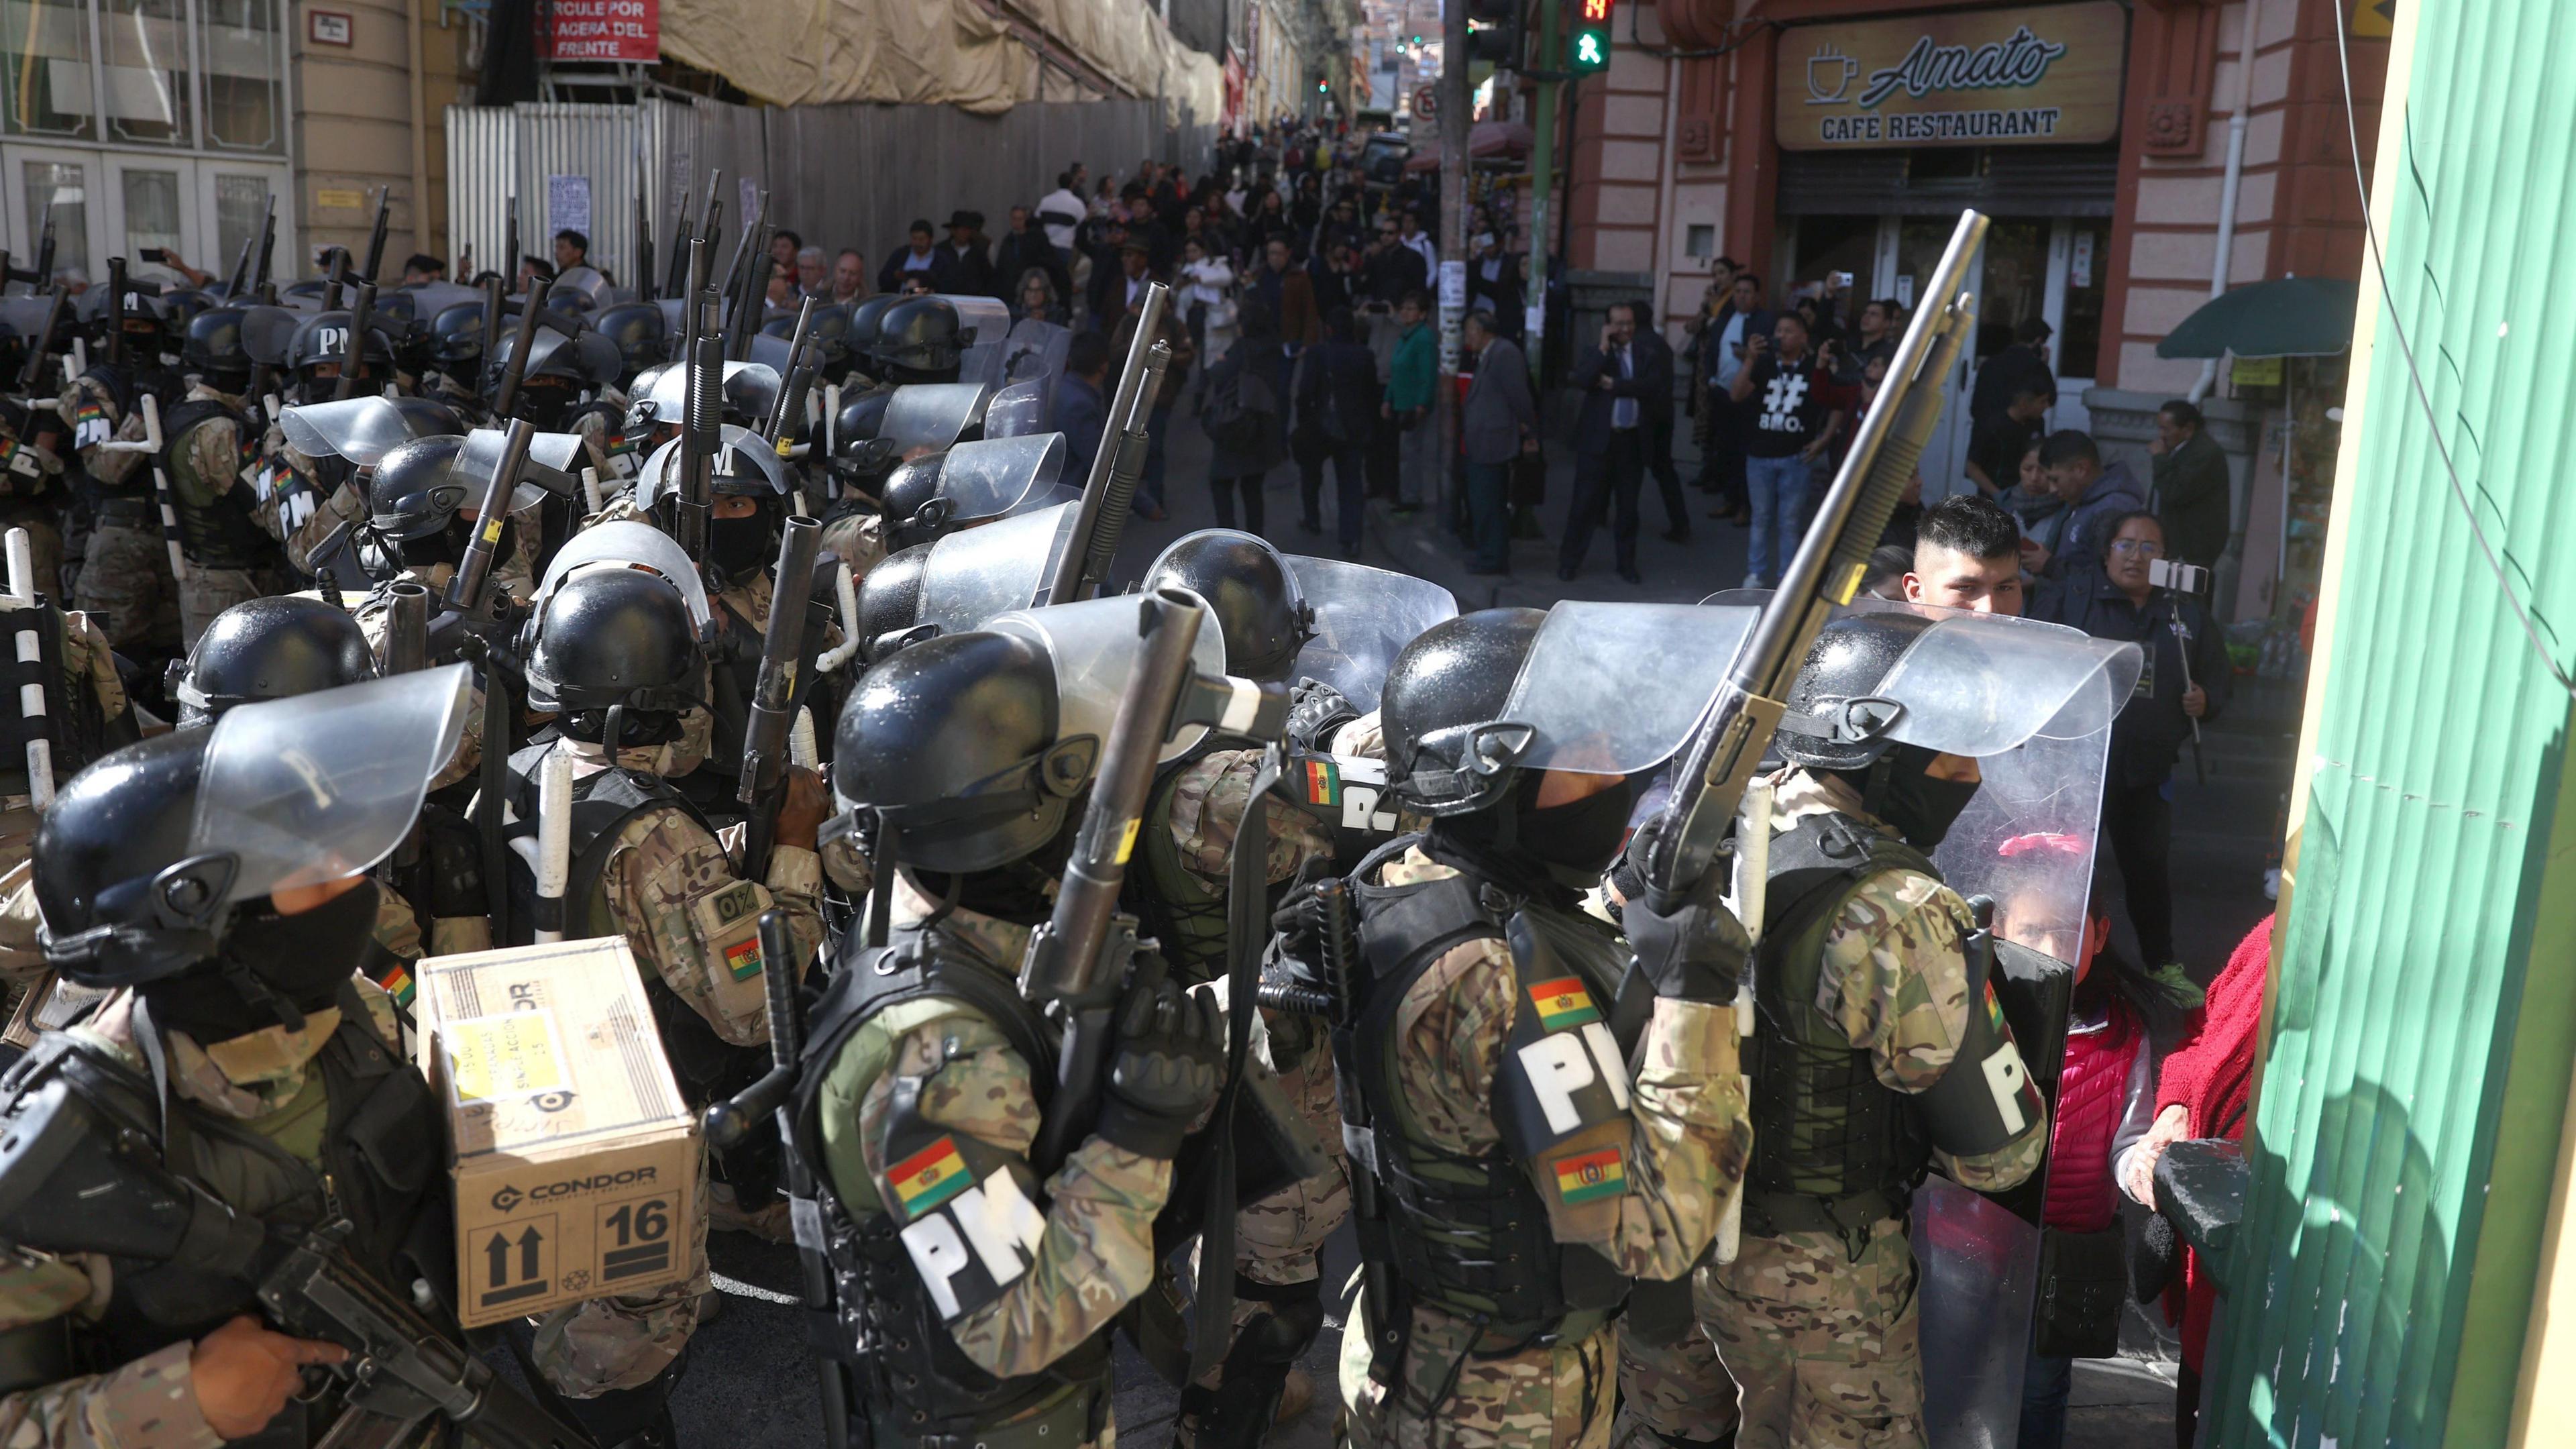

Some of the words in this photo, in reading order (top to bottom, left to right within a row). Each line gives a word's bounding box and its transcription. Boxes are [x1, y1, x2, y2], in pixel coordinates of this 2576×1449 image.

[535, 1, 604, 17] CRCULE
[608, 1, 645, 17] POR
[557, 21, 609, 37] ACERA
[613, 21, 649, 38] DEL
[557, 41, 620, 56] FRENTE
[1859, 25, 2065, 107] Amato
[1887, 108, 2059, 140] RESTAURANT
[123, 291, 139, 311] M
[74, 417, 111, 450] PM
[712, 442, 735, 477] M
[278, 490, 316, 541] PM
[529, 1165, 657, 1200] CONDOR
[604, 1200, 668, 1248] 16
[900, 1164, 1046, 1321] PM
